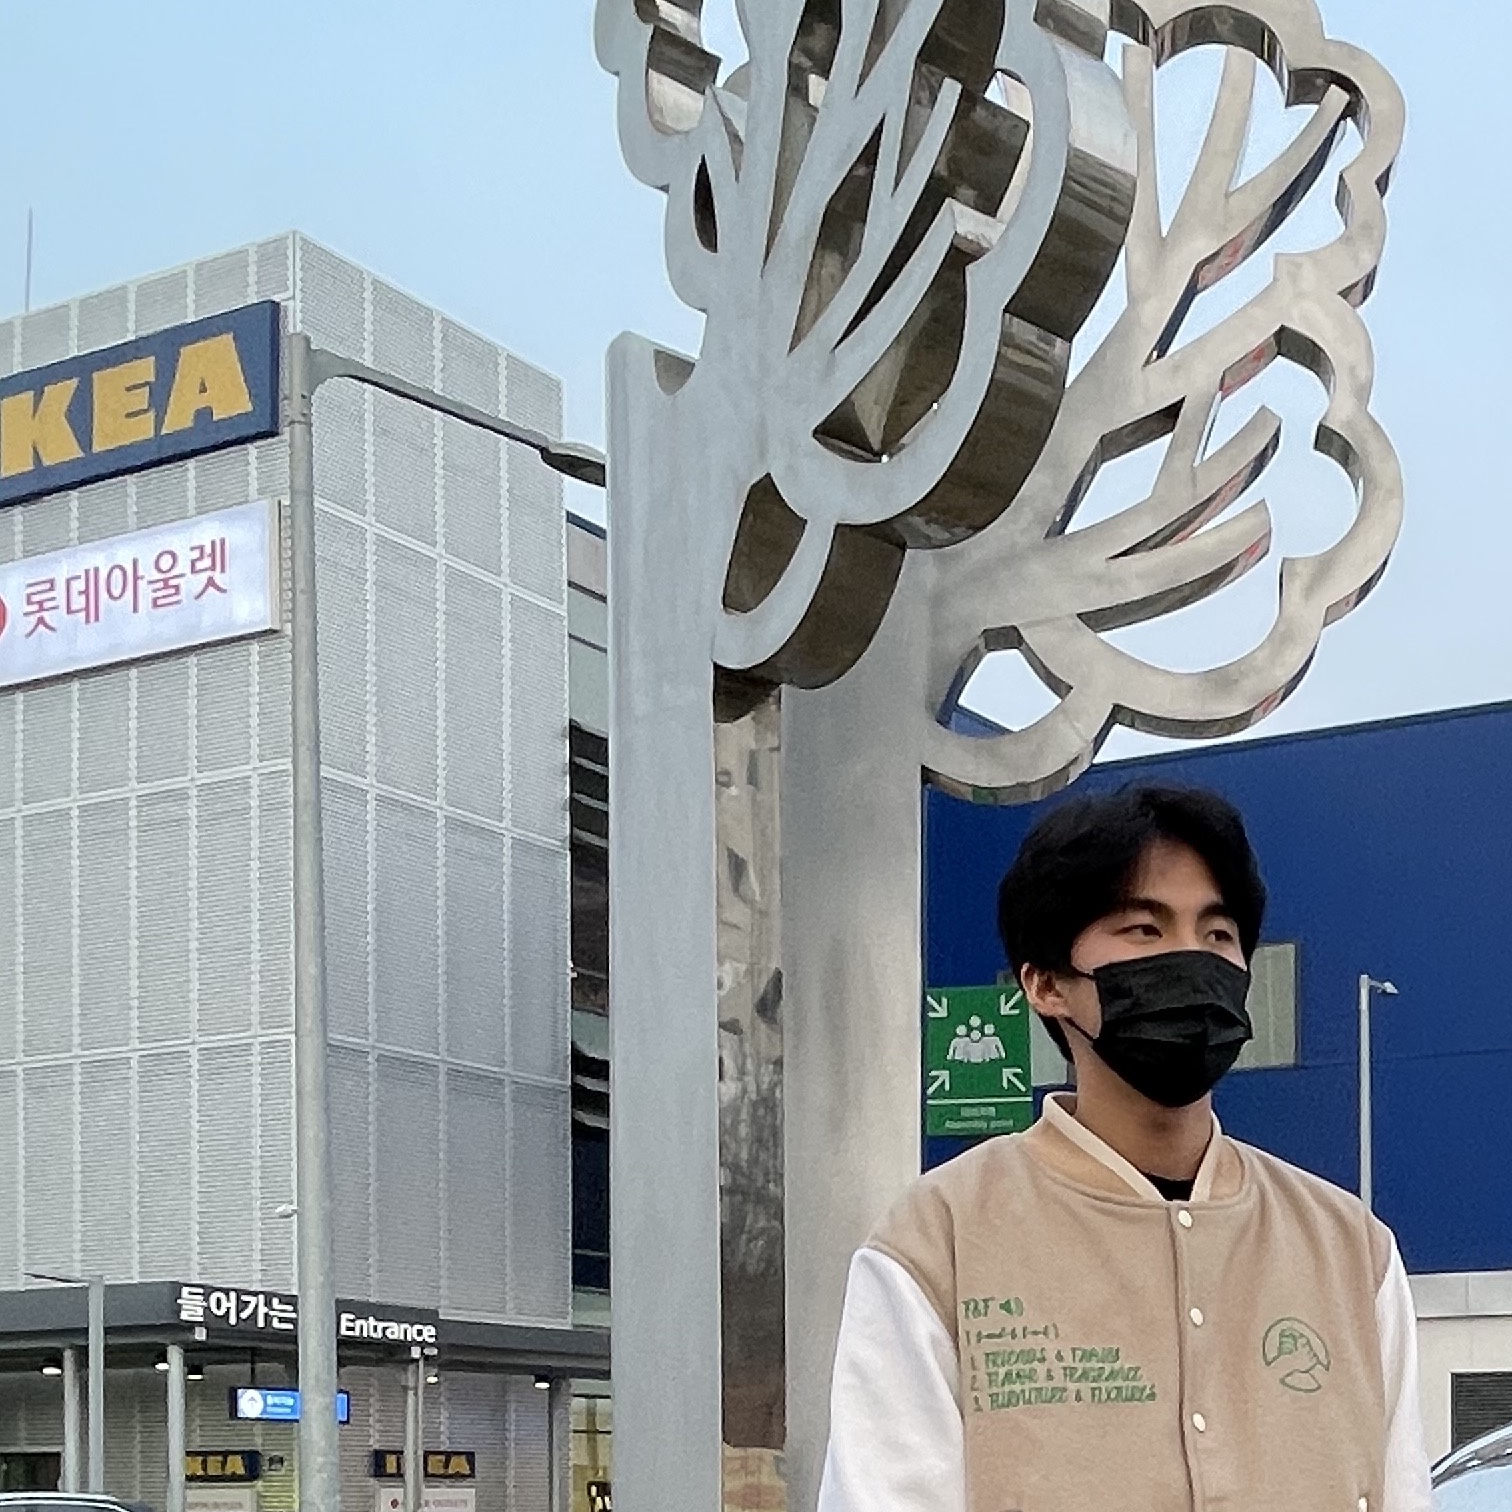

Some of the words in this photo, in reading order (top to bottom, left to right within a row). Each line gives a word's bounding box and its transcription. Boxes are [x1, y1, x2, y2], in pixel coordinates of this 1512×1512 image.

[23, 537, 228, 638] 롯데아울렛
[177, 1286, 297, 1330] 들어가는
[340, 1313, 436, 1342] Entrance
[386, 1454, 471, 1474] IEA
